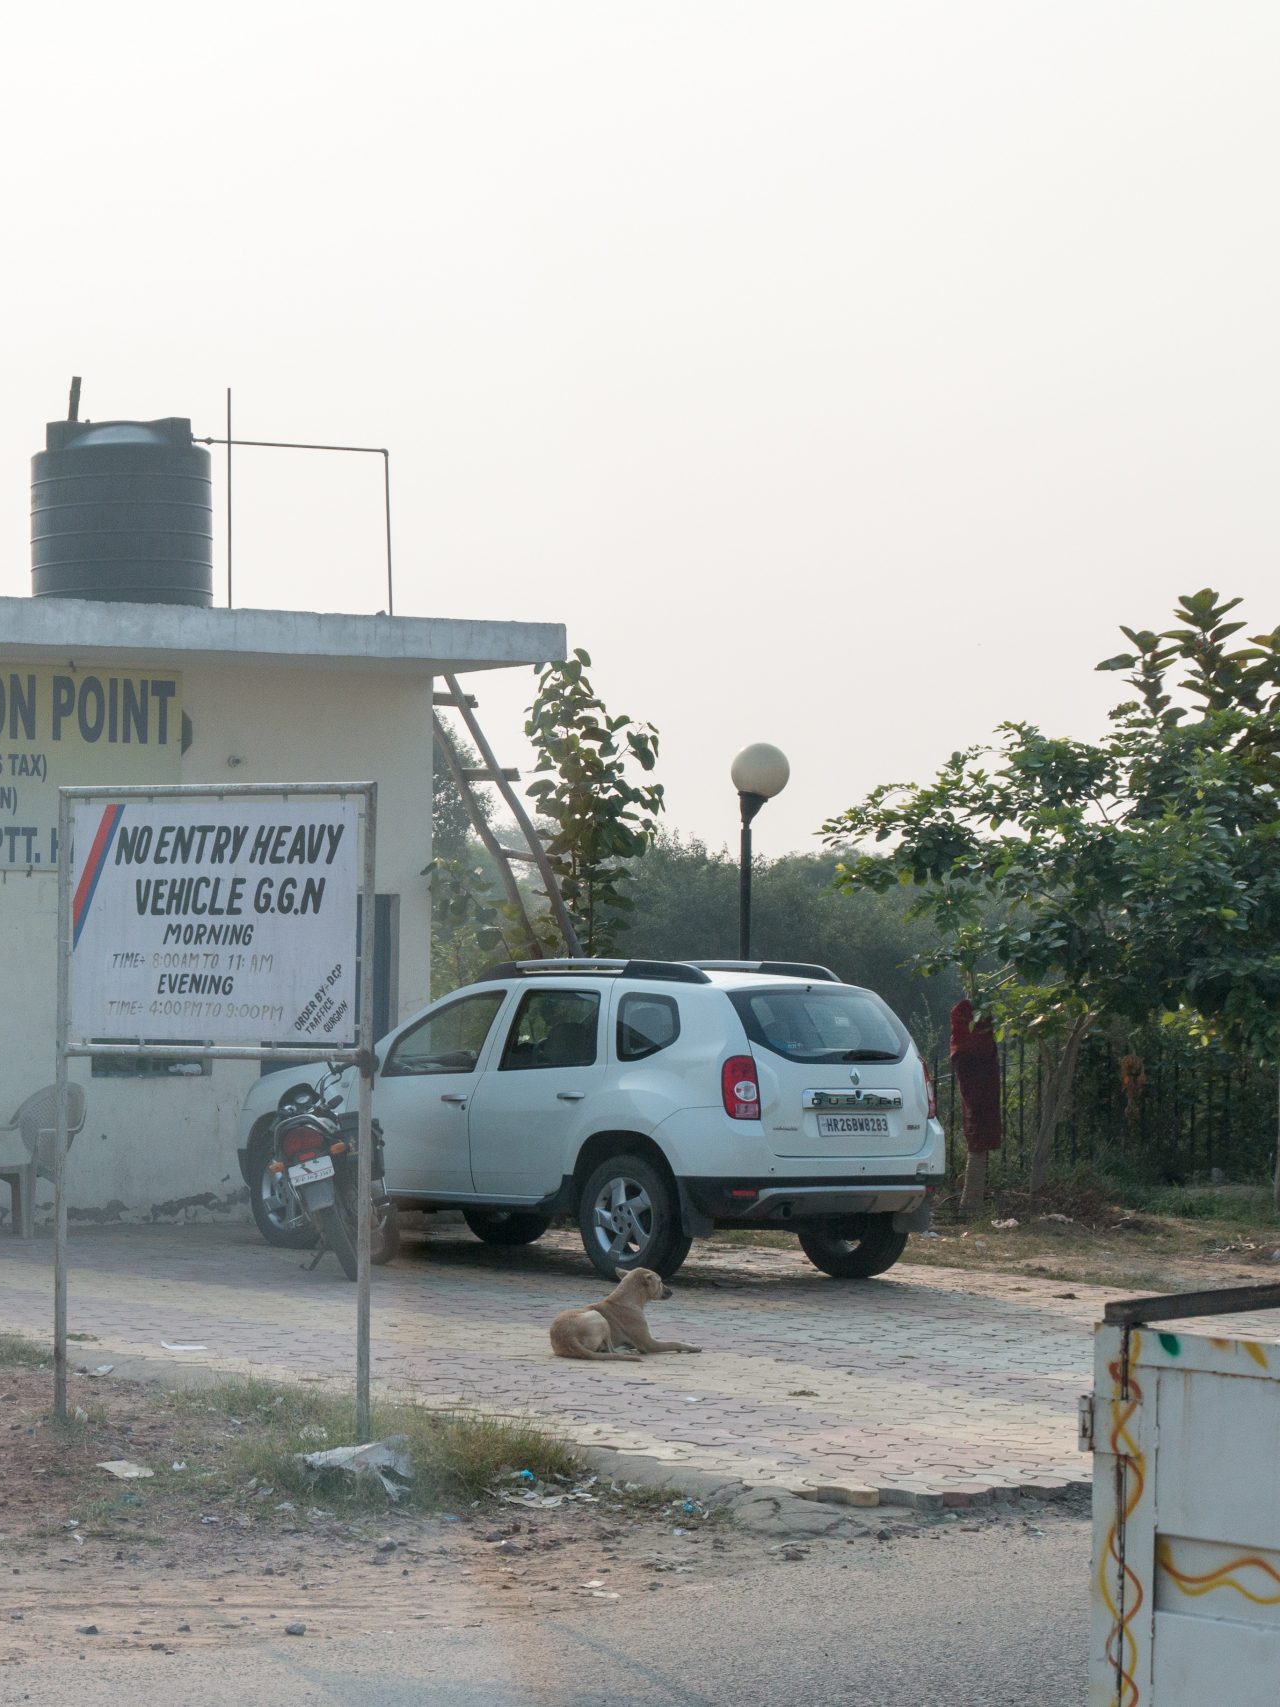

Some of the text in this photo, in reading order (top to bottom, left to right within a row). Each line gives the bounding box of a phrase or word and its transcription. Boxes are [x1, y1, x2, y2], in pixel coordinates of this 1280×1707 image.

[51, 675, 176, 745] POINT
[7, 752, 48, 783] TAX)
[115, 825, 153, 866] NO
[153, 824, 249, 865] ENTRY
[249, 823, 345, 865] HEAVY
[135, 876, 247, 916] VEHICLE
[162, 923, 255, 946] MORNING
[202, 952, 220, 970] TO
[156, 973, 235, 996] EVENING
[204, 1001, 222, 1018] TO
[294, 1000, 318, 1031] ORDER
[305, 997, 335, 1035] TRAFFICE
[323, 1000, 349, 1033] GURGAON
[811, 1097, 902, 1106] DUSTER
[826, 1117, 889, 1133] HR26BW8283
